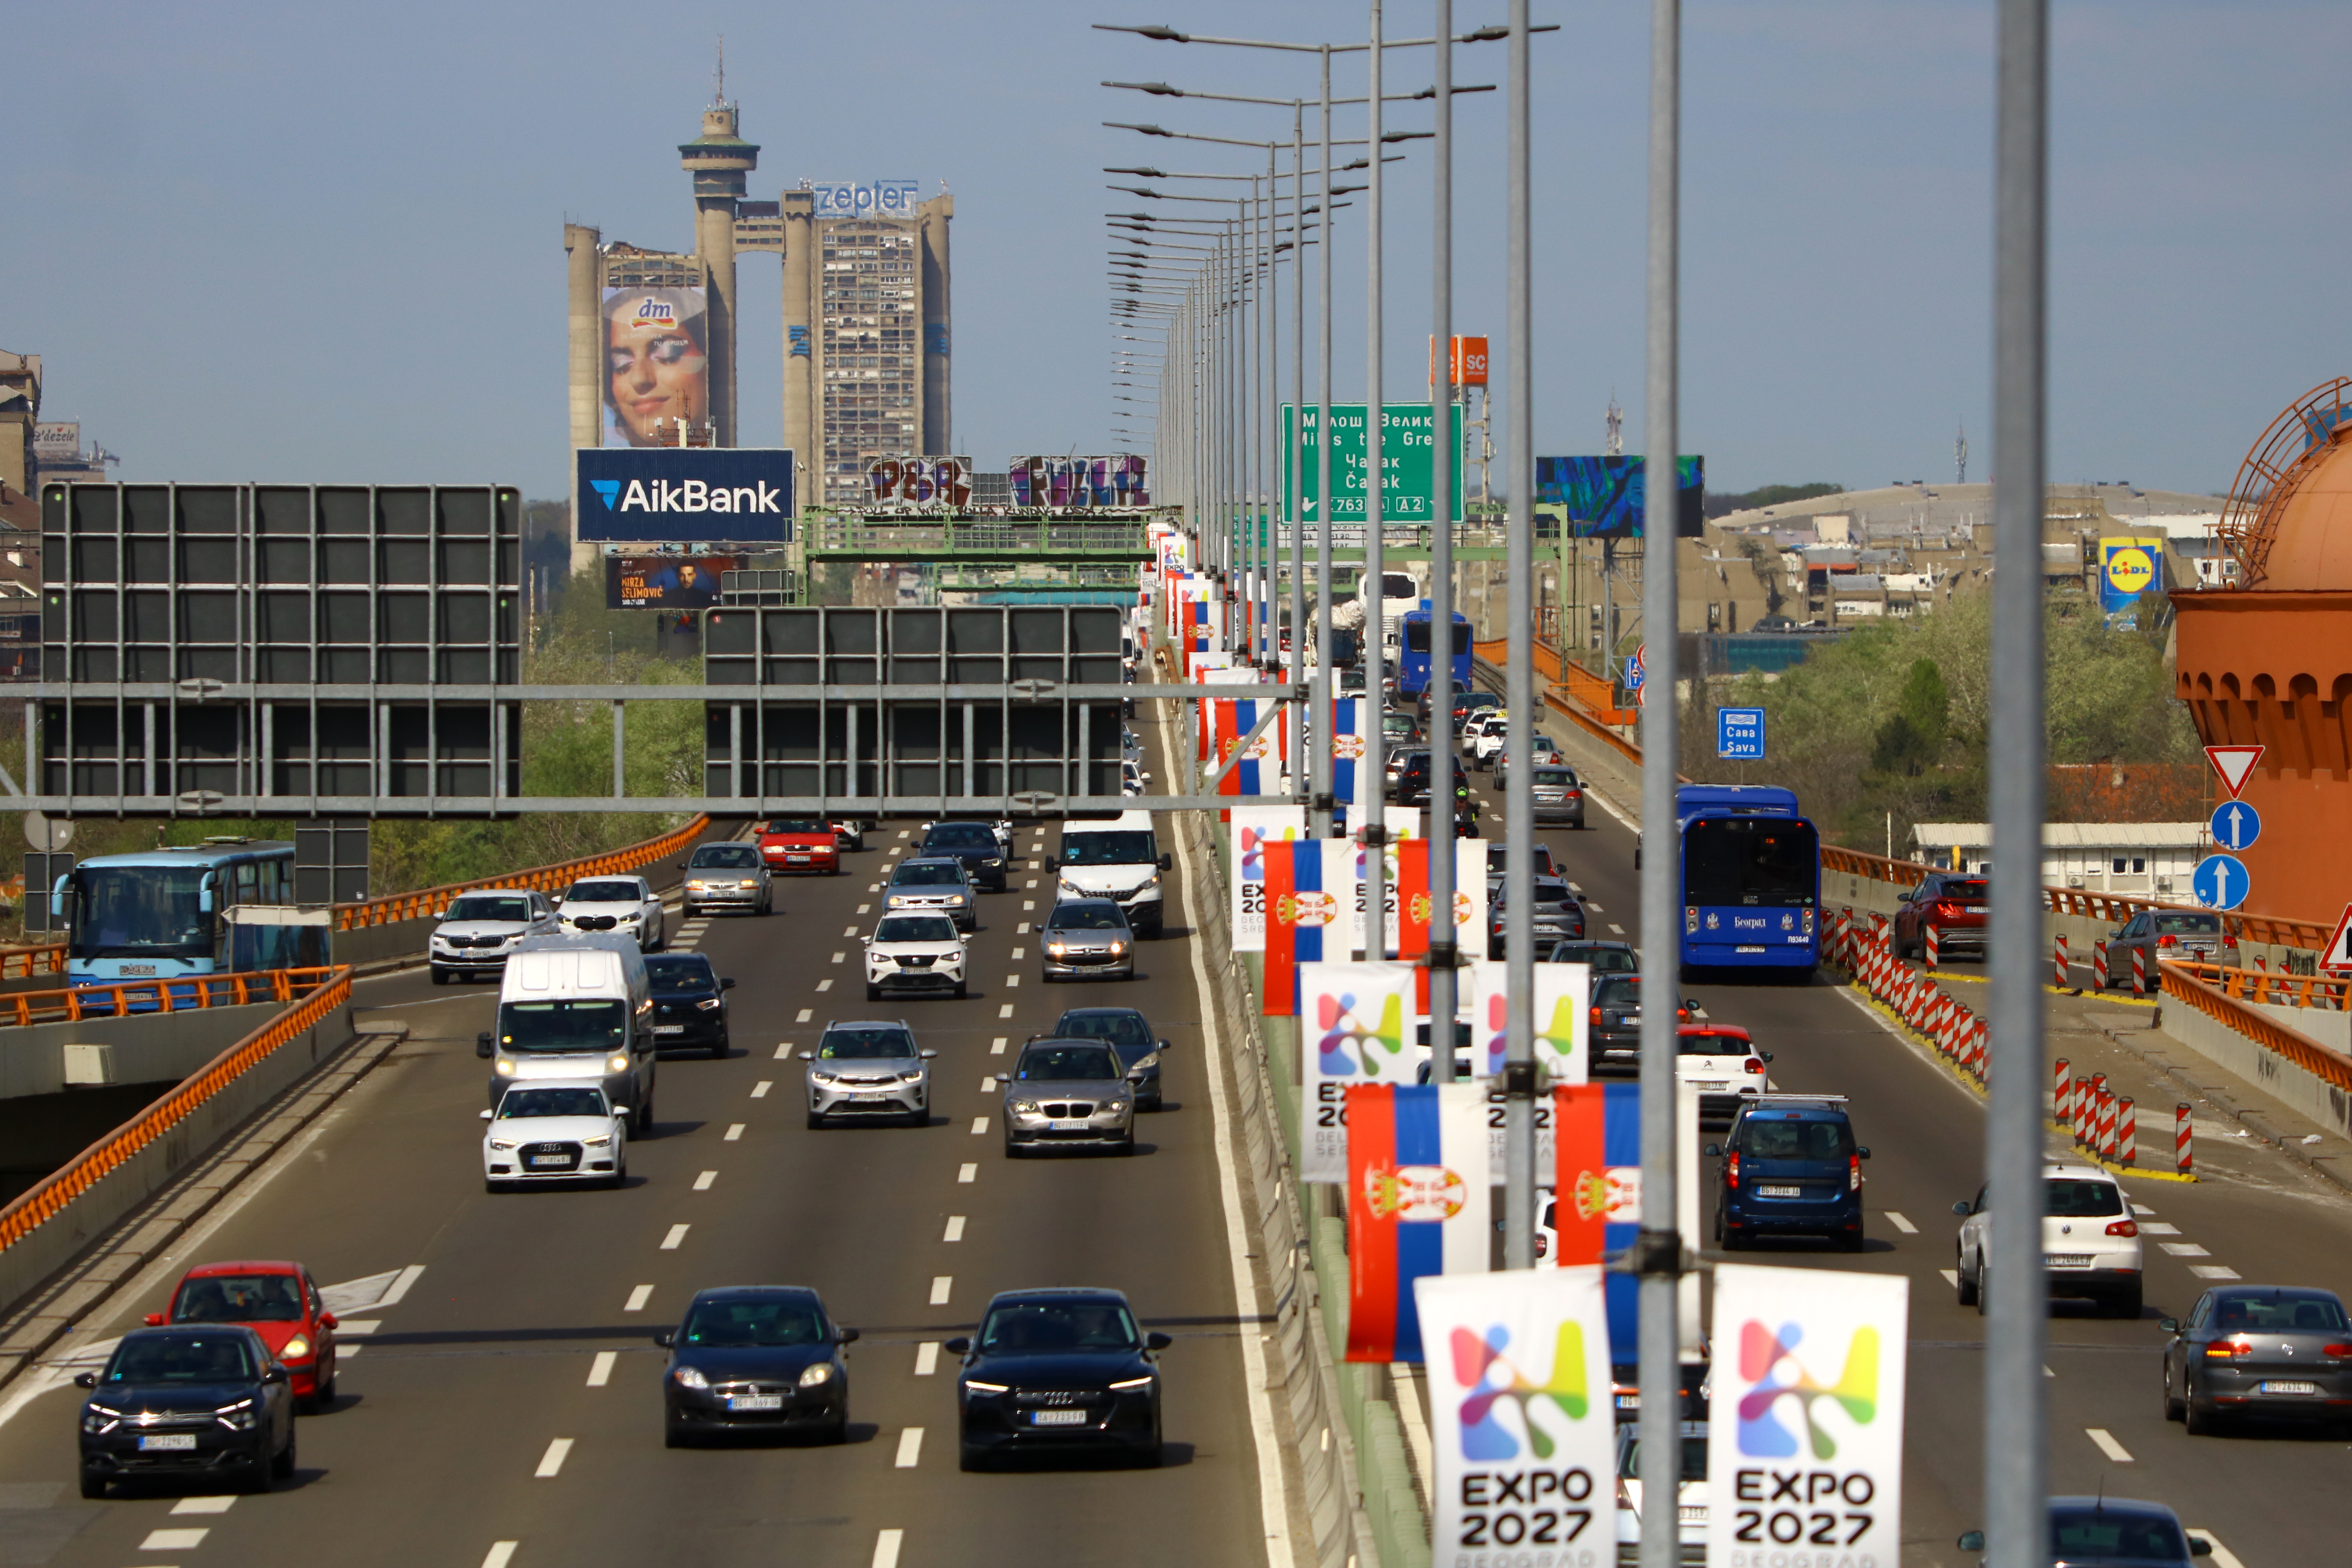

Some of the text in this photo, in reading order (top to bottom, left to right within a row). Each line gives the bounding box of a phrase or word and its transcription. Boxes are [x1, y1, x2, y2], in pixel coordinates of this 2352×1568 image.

[815, 180, 918, 216] zepter
[639, 299, 670, 318] dm
[1466, 354, 1486, 370] SC
[1303, 413, 1432, 427] Млош Велик
[1403, 431, 1432, 446] Gre
[1346, 453, 1400, 468] Чаак
[1346, 470, 1400, 489] Čaak
[621, 479, 781, 513] AikBank
[622, 577, 644, 588] MIRZA
[1726, 726, 1755, 737] Сава
[1727, 741, 1755, 752] Sava
[1735, 916, 1766, 929] Београд
[1761, 1186, 1770, 1195] BG
[1622, 1396, 1633, 1406] BG
[1462, 1469, 1593, 1506] EXPO
[1736, 1469, 1874, 1506] EXPO
[1461, 1510, 1592, 1546] 2027
[1736, 1510, 1872, 1545] 2027
